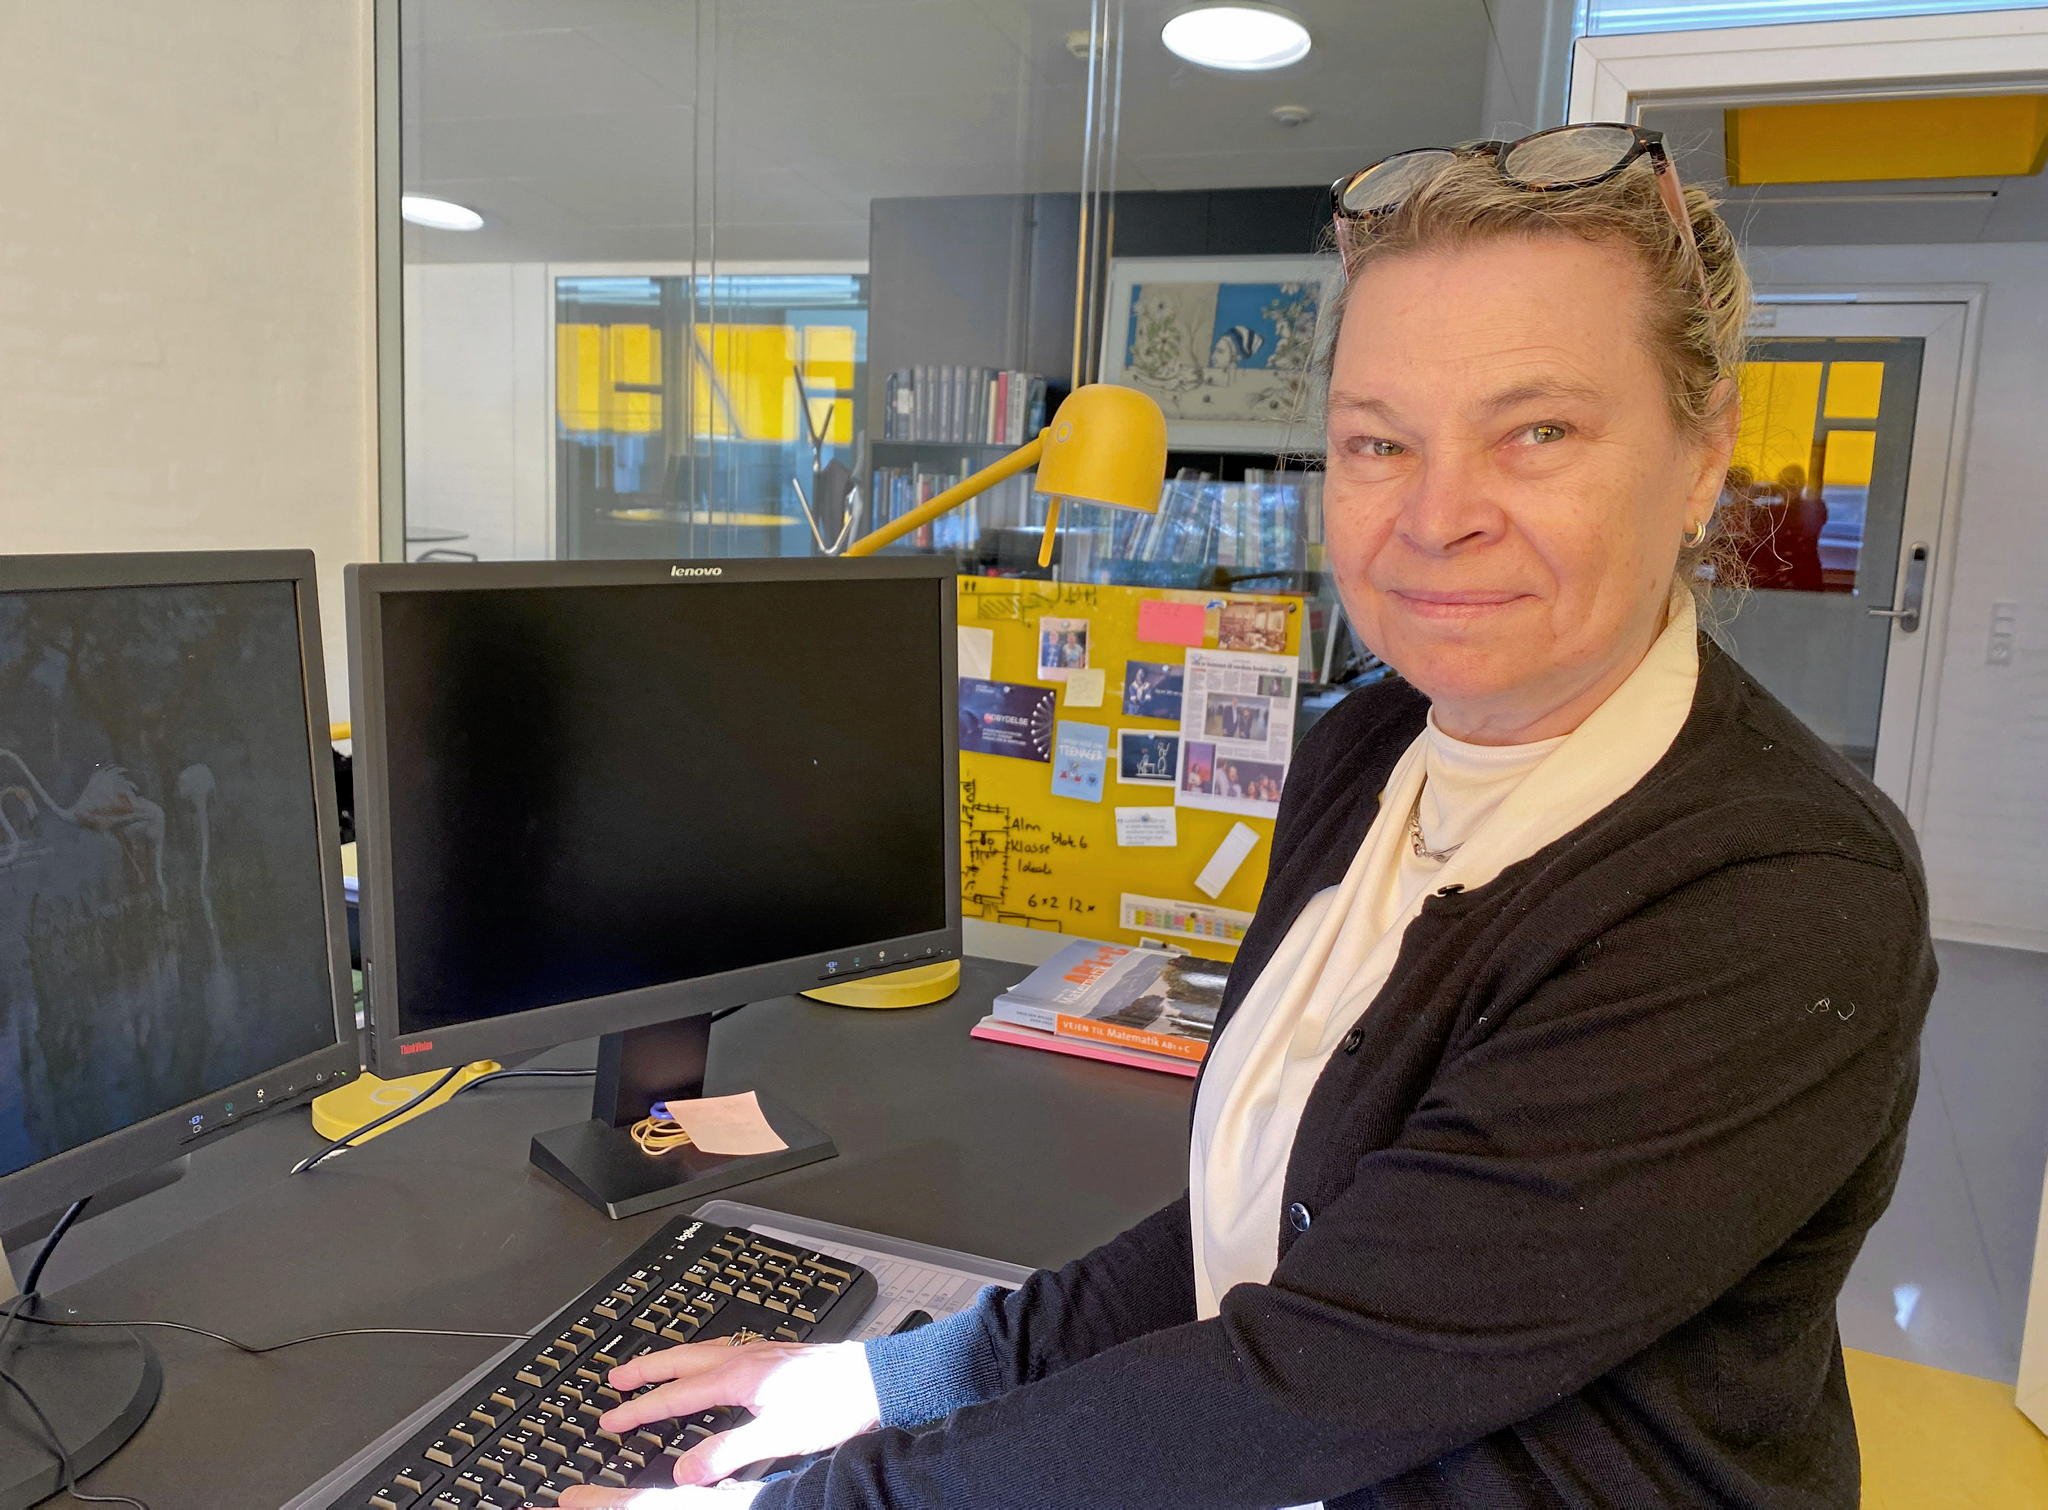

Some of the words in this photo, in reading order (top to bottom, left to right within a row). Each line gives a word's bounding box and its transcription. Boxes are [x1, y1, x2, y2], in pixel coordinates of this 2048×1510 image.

[671, 565, 722, 577] lenovo
[1062, 1020, 1090, 1034] VEJEN
[1092, 1026, 1105, 1036] TIL
[1106, 1027, 1160, 1048] Matematik
